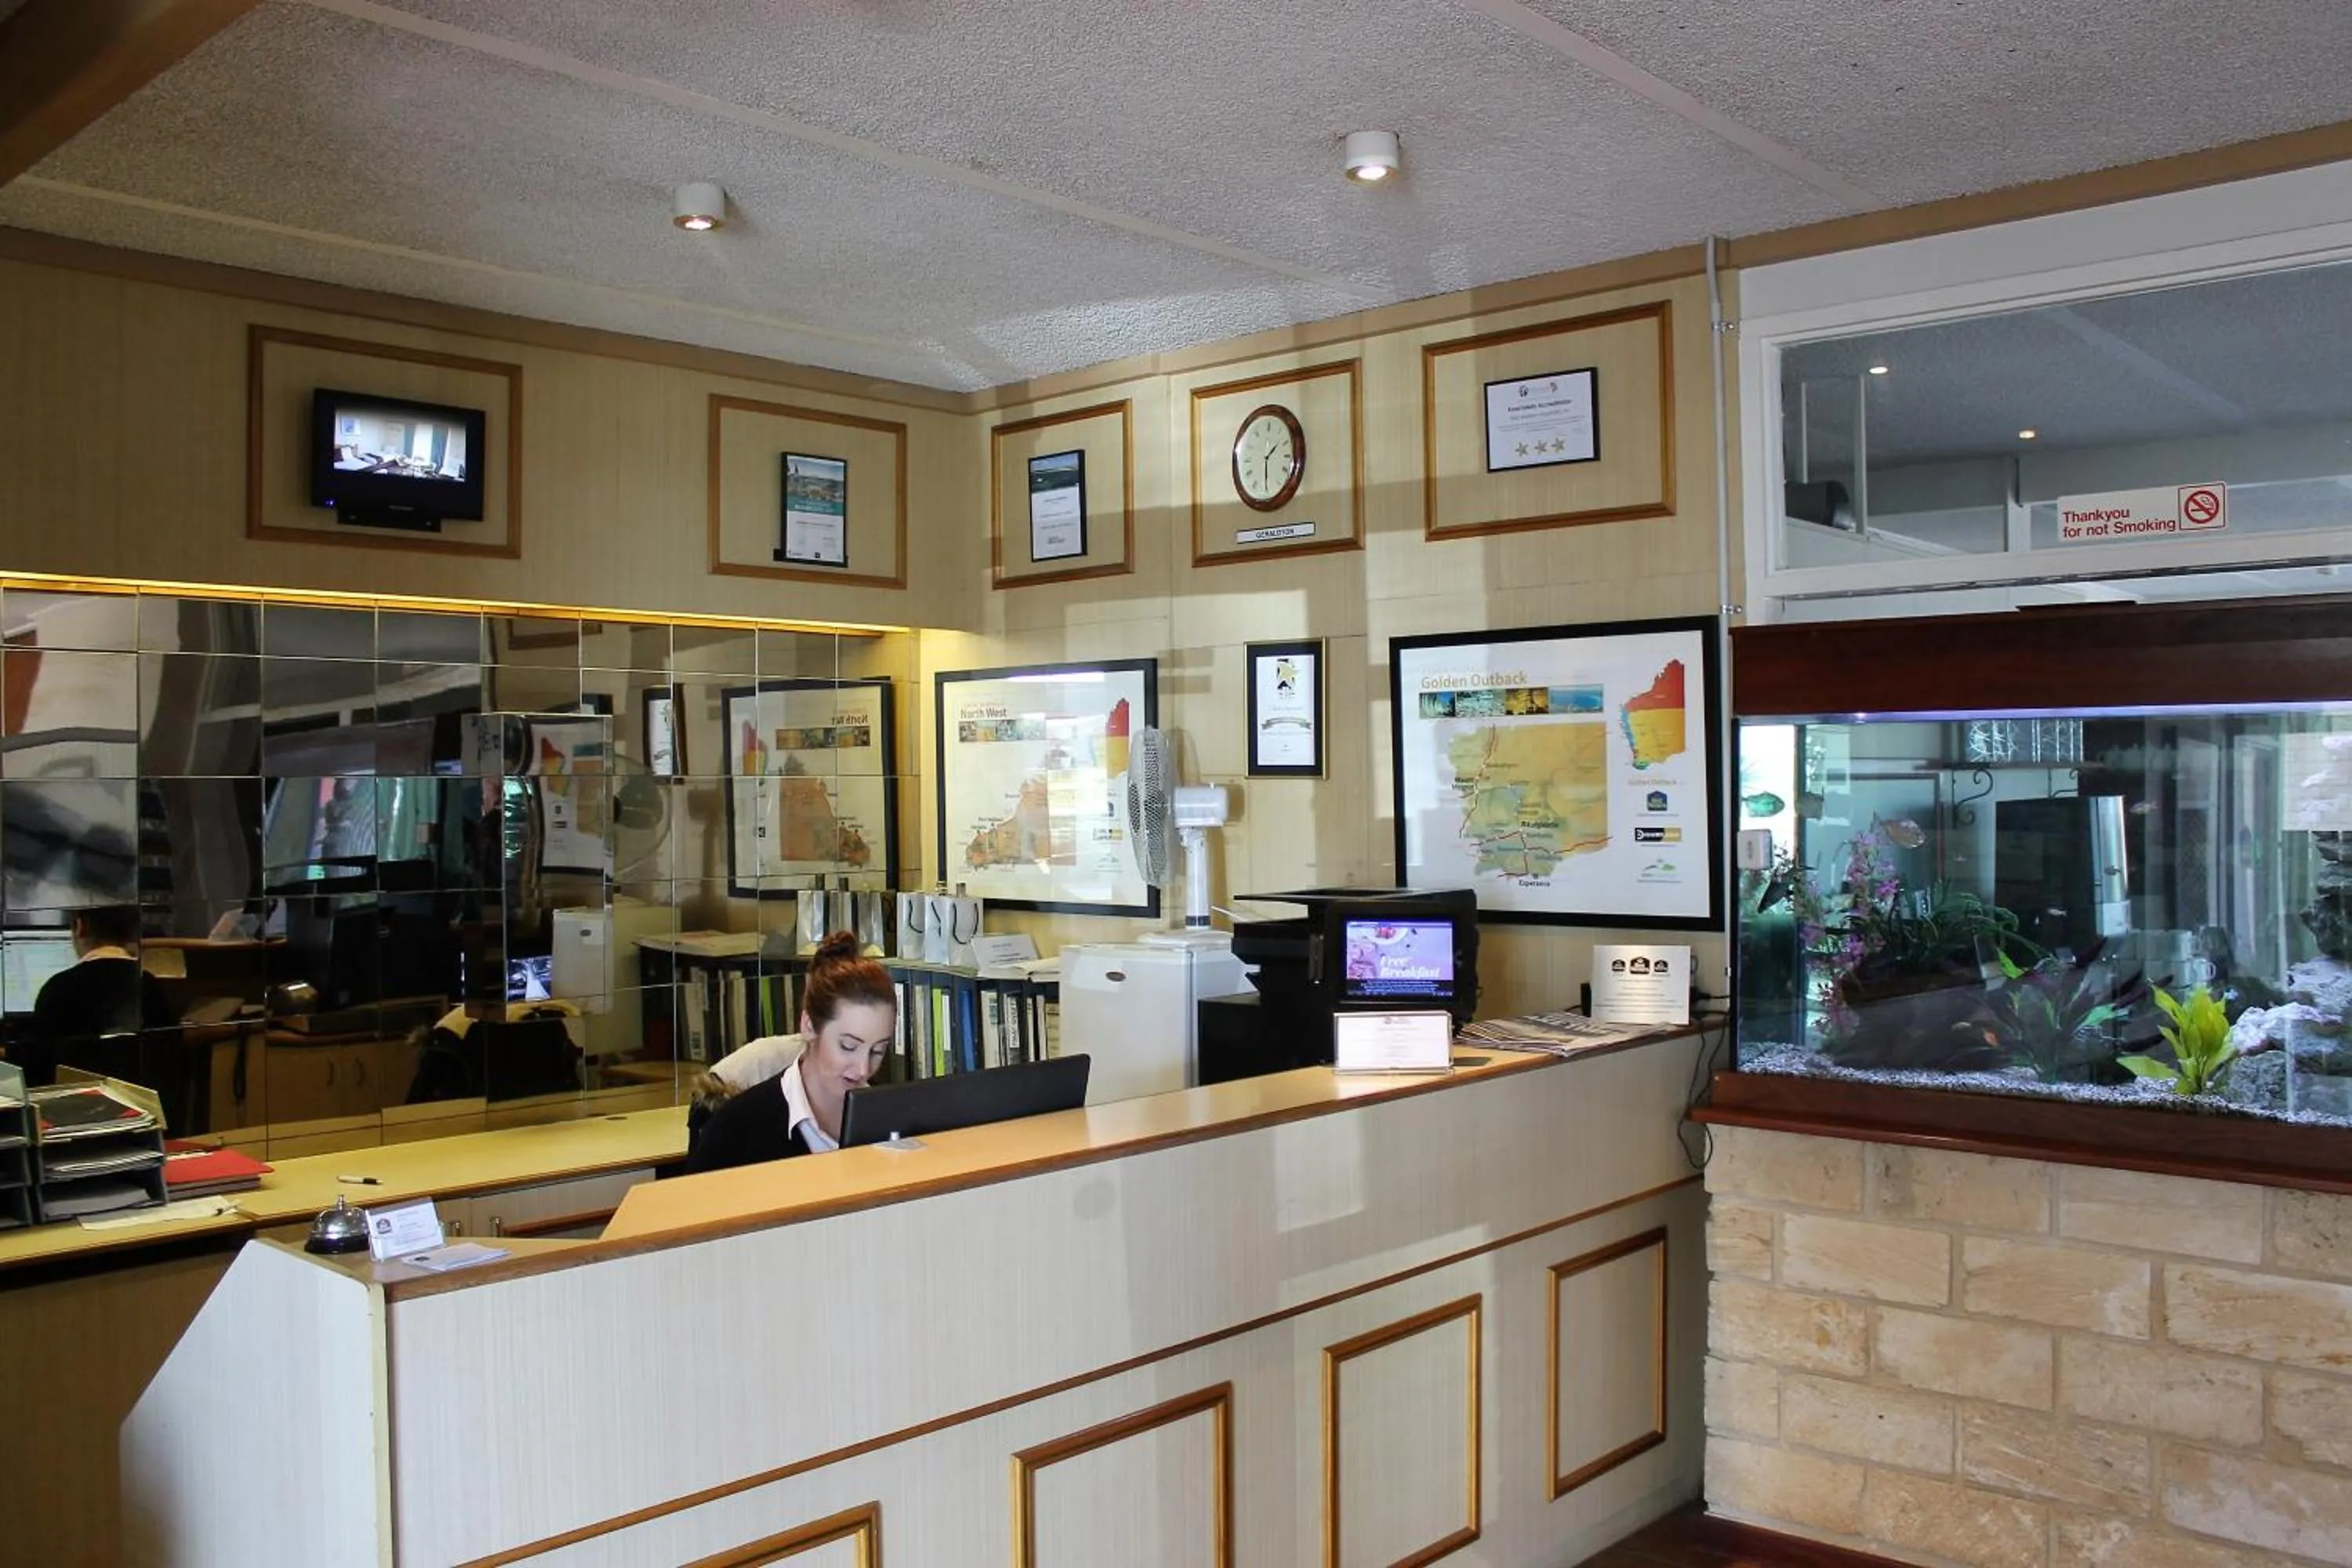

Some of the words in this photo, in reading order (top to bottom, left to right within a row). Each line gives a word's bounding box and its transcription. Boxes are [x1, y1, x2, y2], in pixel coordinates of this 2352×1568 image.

[2063, 508, 2131, 524] Thankyou
[2063, 526, 2082, 538] for
[2086, 524, 2109, 536] not
[2114, 519, 2176, 533] Smoking
[1421, 673, 1468, 689] Golden
[1470, 668, 1528, 687] Outback
[960, 707, 985, 719] North
[985, 707, 1007, 717] West
[1380, 955, 1410, 967] Free
[1380, 965, 1441, 979] Breakfast
